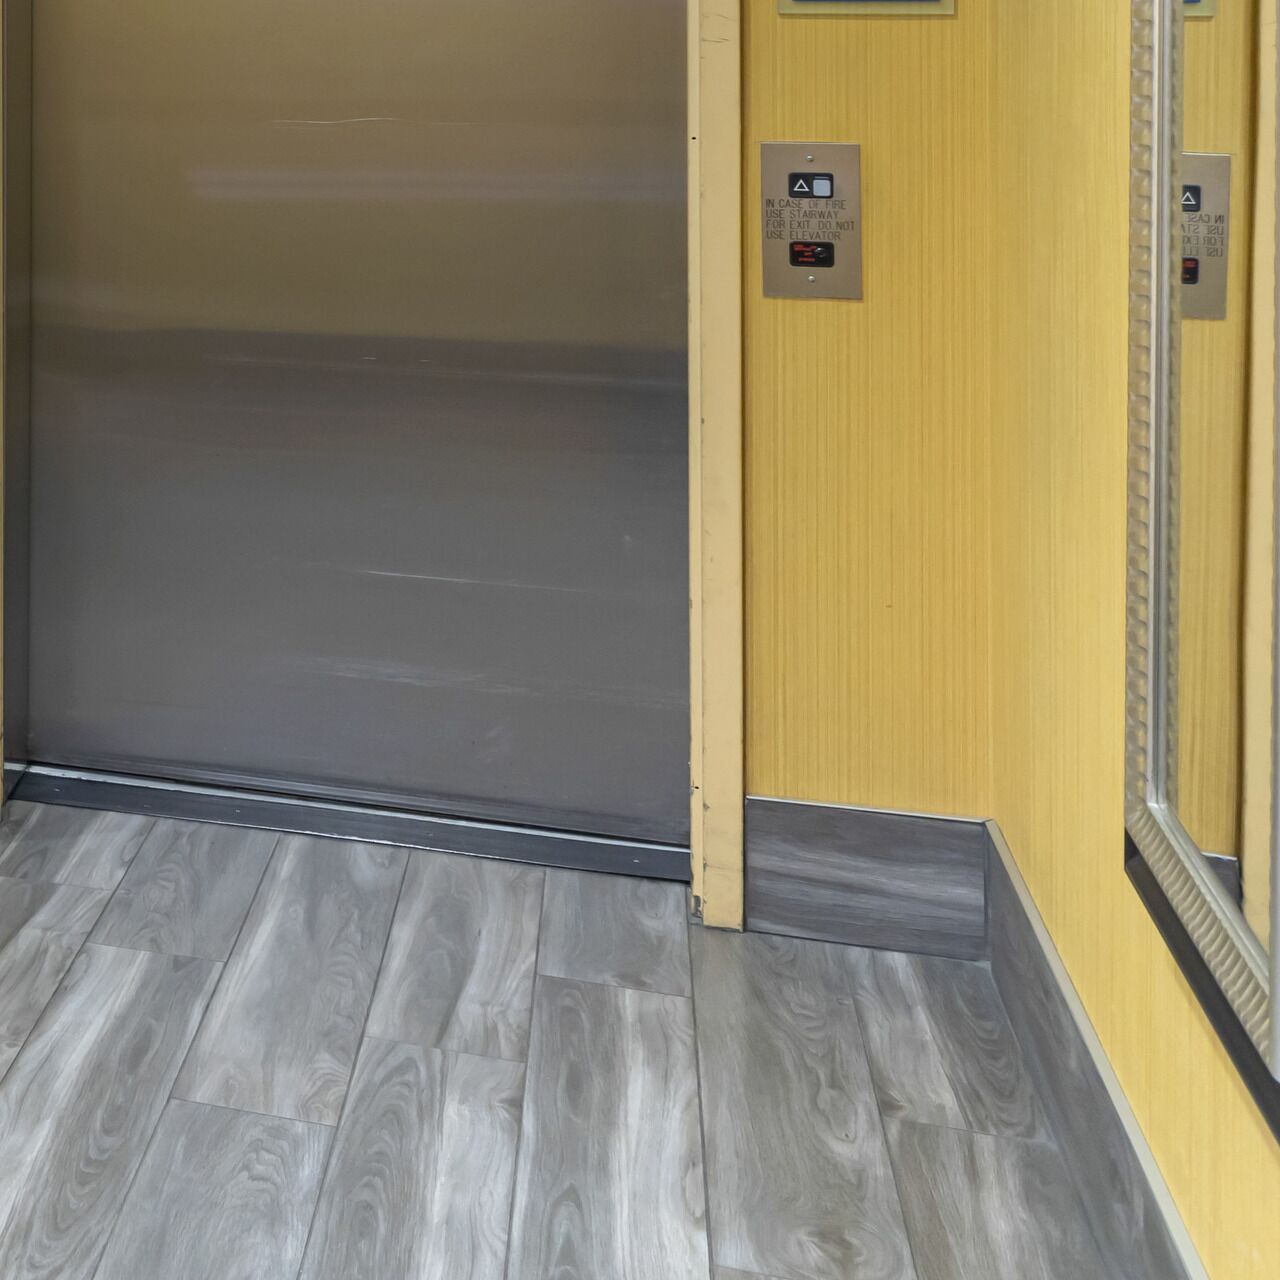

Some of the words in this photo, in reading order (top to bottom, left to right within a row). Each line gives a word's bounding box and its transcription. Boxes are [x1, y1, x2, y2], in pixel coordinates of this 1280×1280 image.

[765, 199, 775, 208] IN
[778, 199, 804, 209] CASE
[808, 200, 820, 209] OF
[825, 200, 847, 210] FIRE
[765, 209, 785, 219] USE
[790, 209, 840, 219] STAIRWAY
[766, 220, 786, 229] FOR
[818, 221, 832, 230] DO
[836, 221, 855, 230] NOT
[766, 230, 785, 240] USE
[790, 230, 841, 241] ELEVATOR
